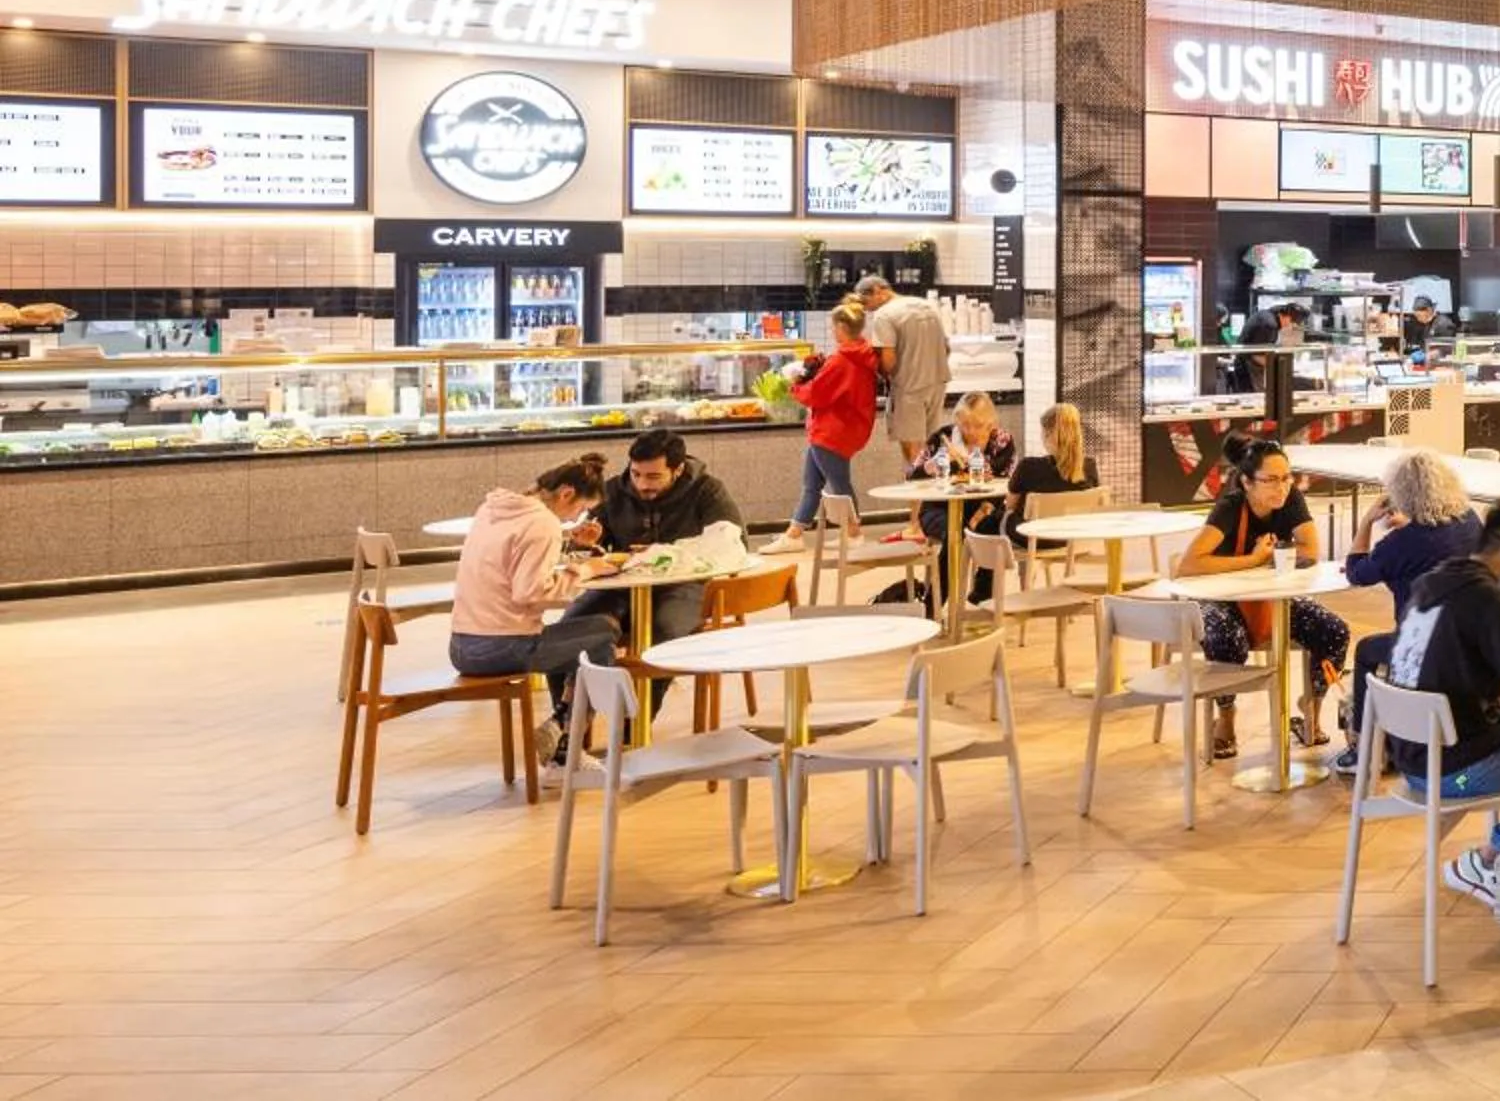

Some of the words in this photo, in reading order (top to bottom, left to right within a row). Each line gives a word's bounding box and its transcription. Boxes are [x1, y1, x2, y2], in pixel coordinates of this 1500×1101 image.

[1172, 41, 1323, 107] SUSHI
[1382, 58, 1473, 117] HUB
[432, 227, 571, 246] CARVERY
